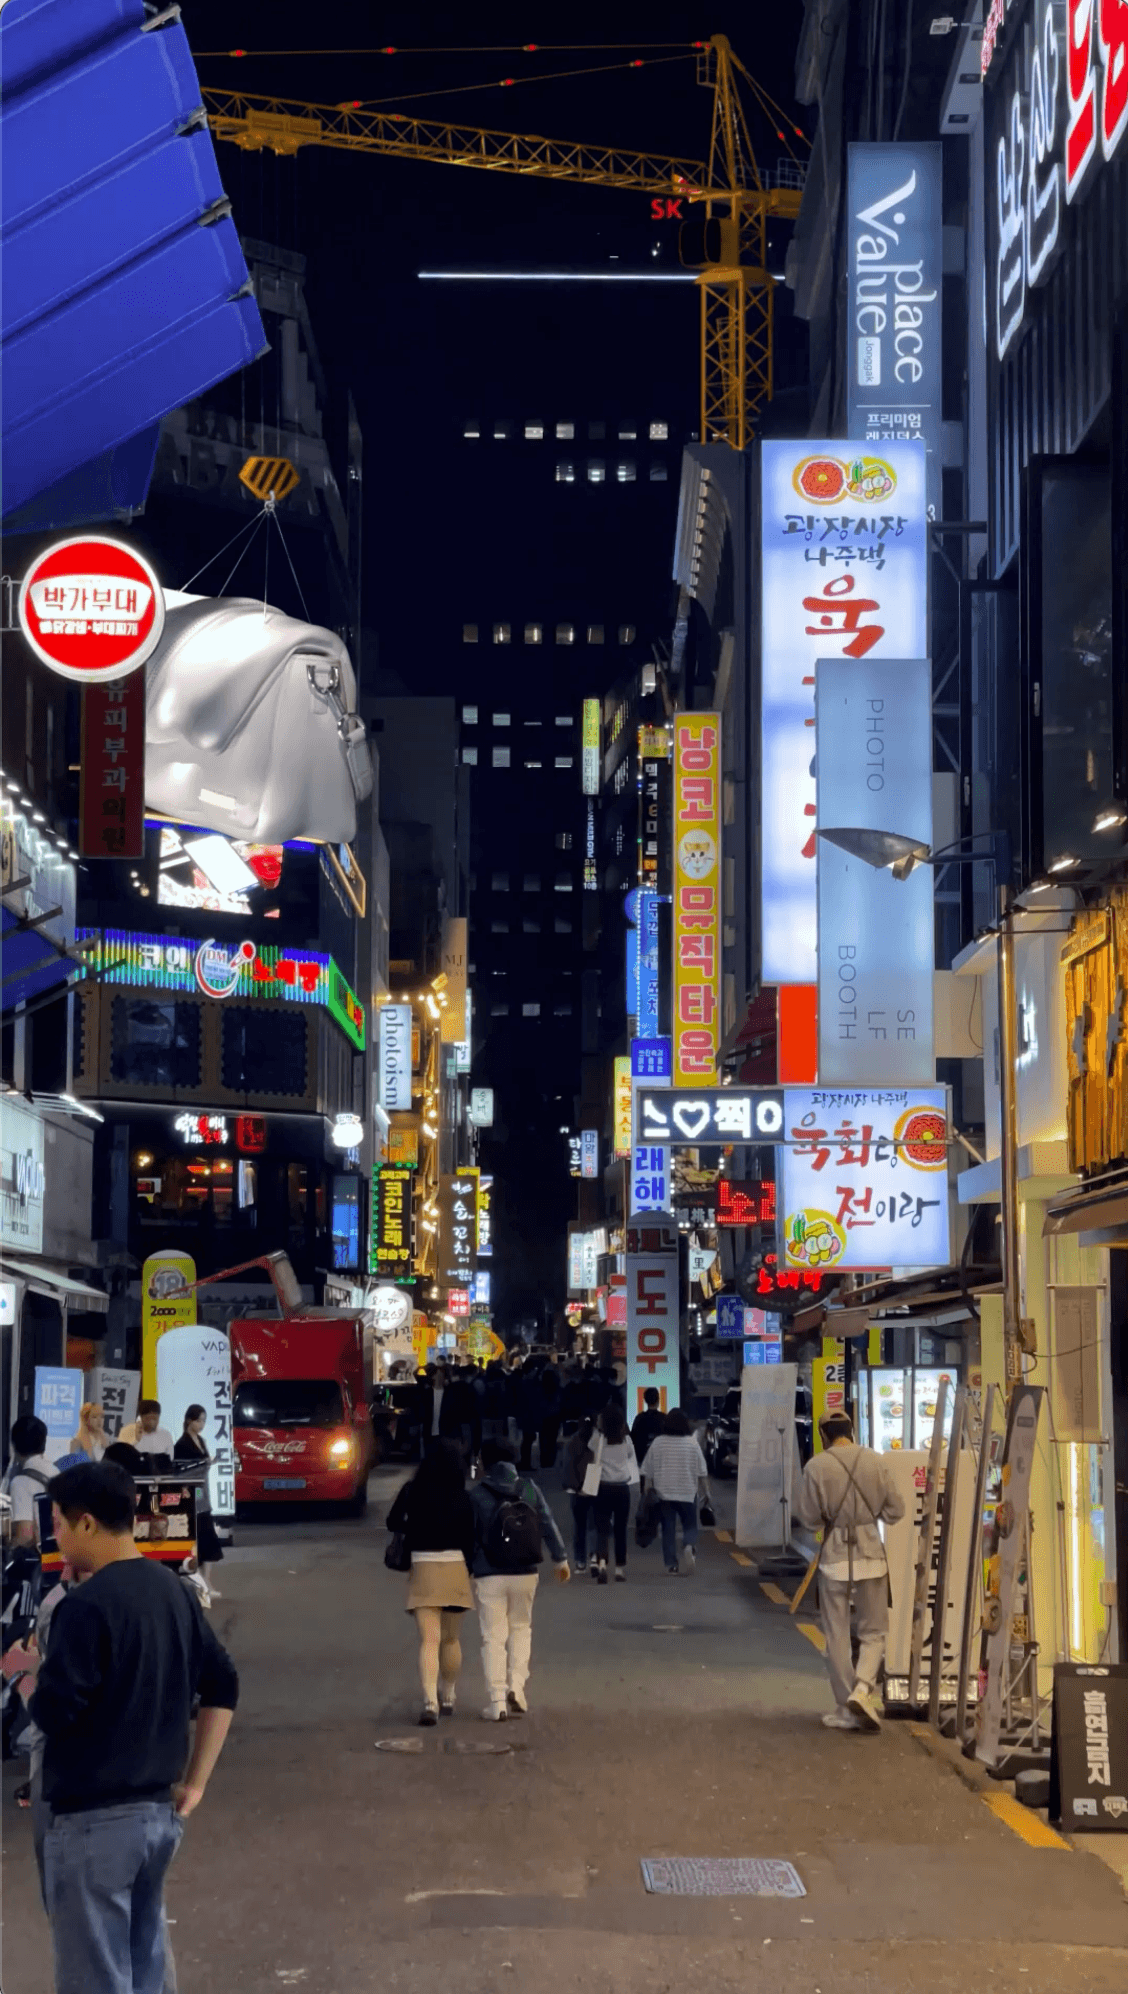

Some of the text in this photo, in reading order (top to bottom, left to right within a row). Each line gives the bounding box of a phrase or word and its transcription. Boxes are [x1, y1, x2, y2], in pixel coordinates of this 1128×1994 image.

[651, 198, 683, 219] SK
[862, 339, 875, 383] Jonggak
[866, 412, 922, 428] 프리미엄
[782, 514, 908, 541] 광장시장
[805, 543, 886, 570] 나주댁
[44, 586, 137, 613] 박가부대
[866, 698, 885, 792] PHOTO
[838, 944, 857, 1040] BOOTH
[381, 1008, 404, 1107] photoism
[834, 1186, 940, 1228] 전이랑
